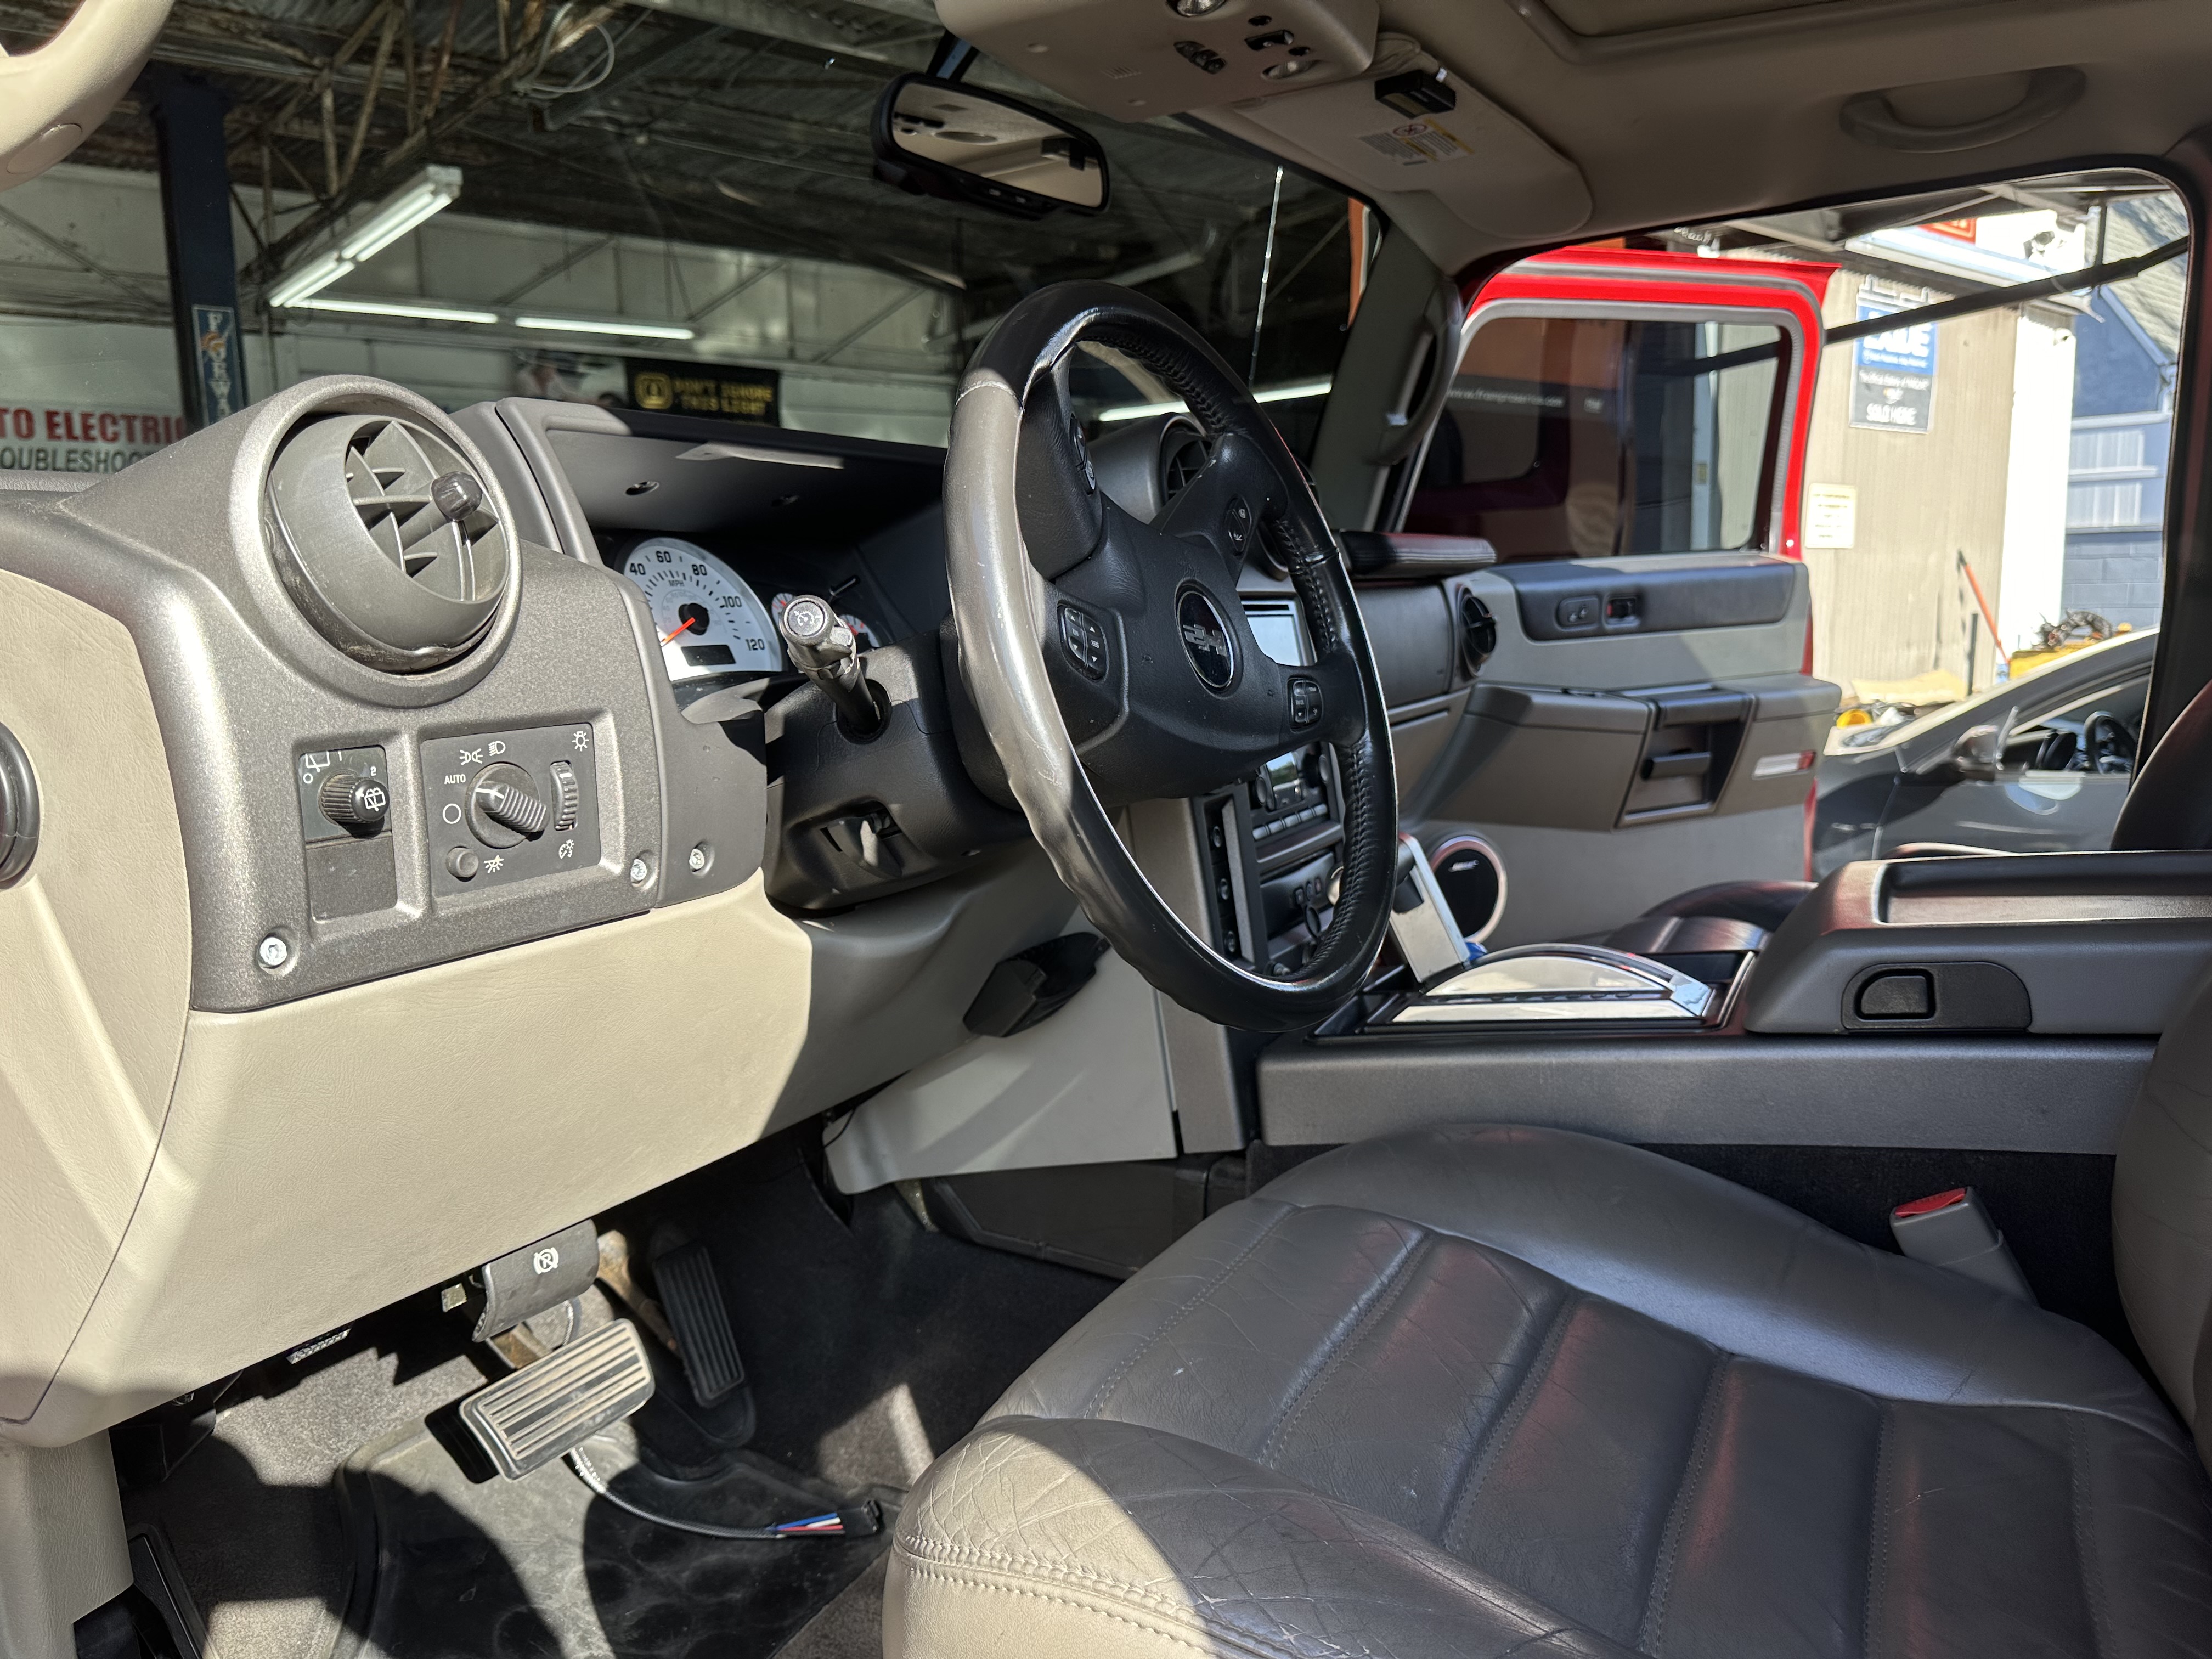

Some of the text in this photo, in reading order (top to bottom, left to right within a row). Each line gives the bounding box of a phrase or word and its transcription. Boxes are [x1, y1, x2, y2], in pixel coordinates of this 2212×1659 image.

[656, 551, 672, 563] 60
[630, 563, 646, 575] 40
[691, 564, 707, 576] 80
[723, 596, 742, 608] 100
[746, 639, 765, 651] 120
[370, 766, 377, 776] 2
[444, 774, 466, 785] AUTO
